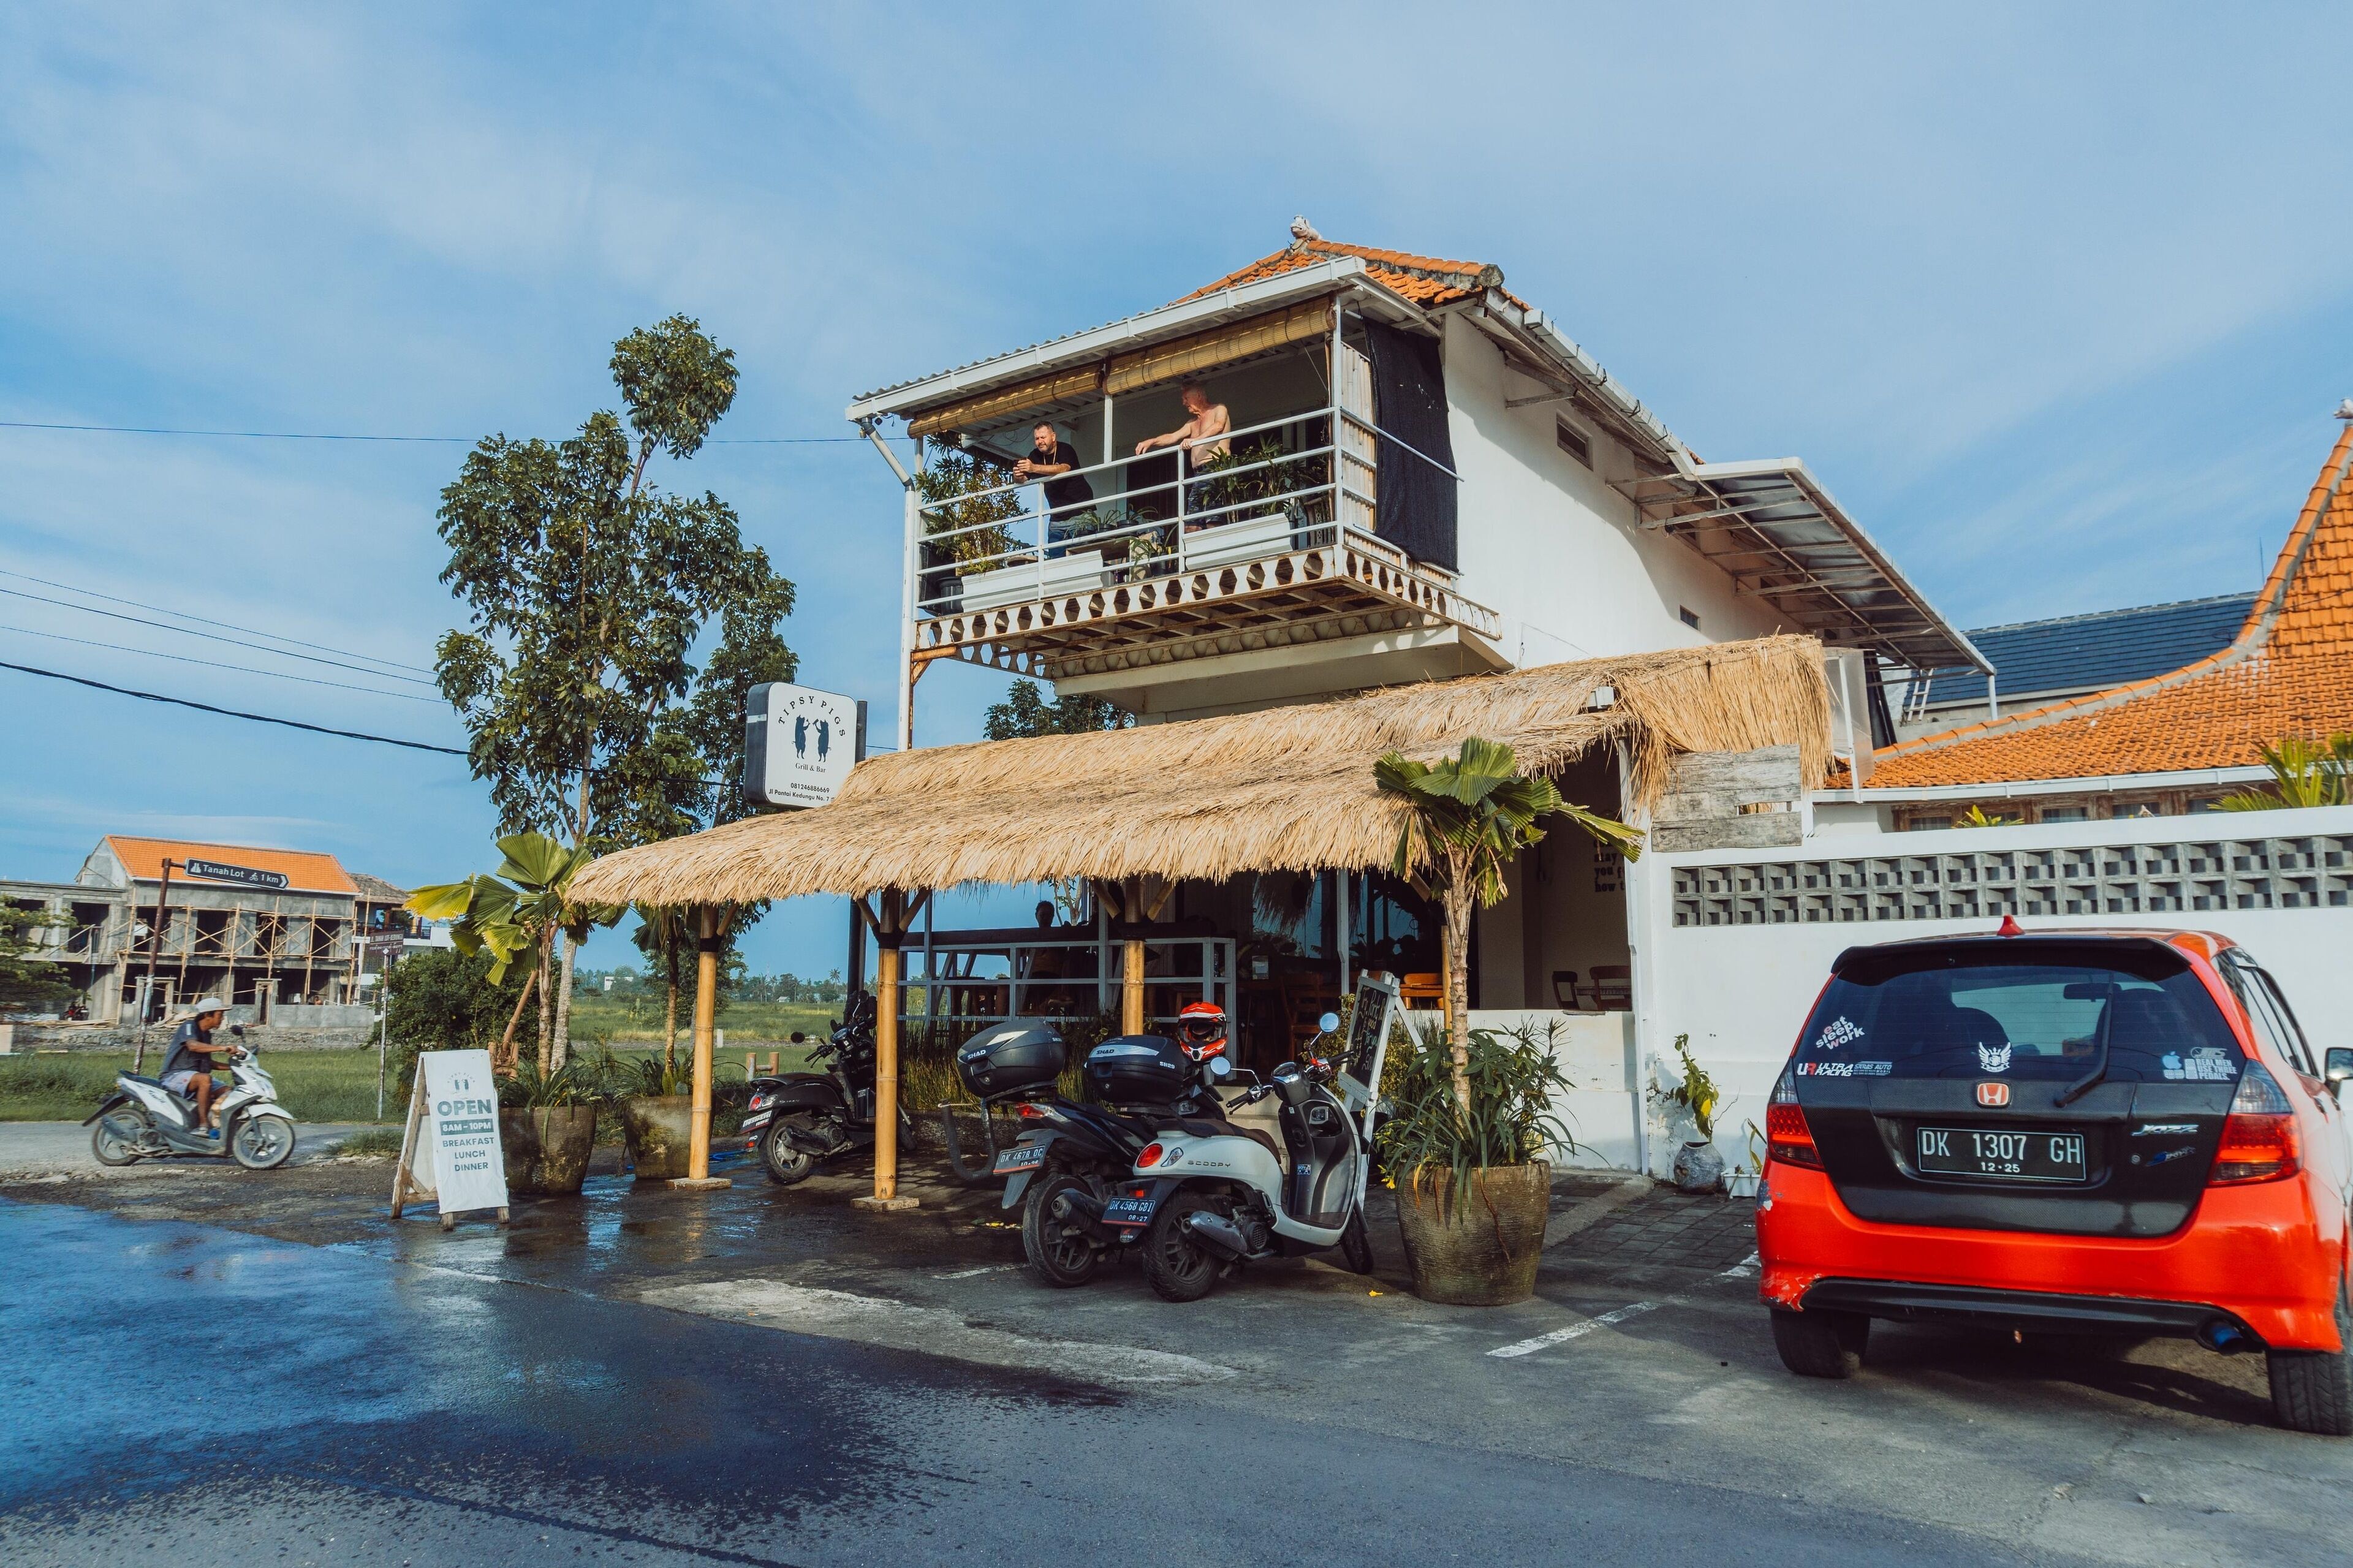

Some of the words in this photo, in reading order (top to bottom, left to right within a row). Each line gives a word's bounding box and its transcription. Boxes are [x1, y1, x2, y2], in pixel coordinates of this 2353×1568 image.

[778, 695, 814, 724] TIPSY
[820, 700, 846, 737] PIGS
[792, 792, 814, 800] Kedungu
[203, 865, 229, 875] Tanah
[230, 869, 244, 877] Lot
[267, 874, 278, 883] km
[1594, 866, 1613, 879] you
[1595, 880, 1616, 892] how
[1824, 1016, 1847, 1034] eat
[1816, 1022, 1854, 1048] sleep
[1826, 1028, 1865, 1050] work
[968, 1050, 986, 1059] SHAD
[438, 1099, 492, 1116] OPEN
[442, 1137, 494, 1147] BREAKFAST
[1922, 1131, 1950, 1156] DK
[1972, 1134, 2026, 1160] 1307
[2050, 1137, 2081, 1164] GH
[455, 1150, 485, 1159] LUNCH
[1001, 1153, 1011, 1163] DK
[1013, 1151, 1030, 1160] 4678
[455, 1162, 488, 1172] DINNER
[1110, 1200, 1120, 1210] DK
[1120, 1201, 1138, 1211] 4568
[1139, 1202, 1153, 1212] GBI
